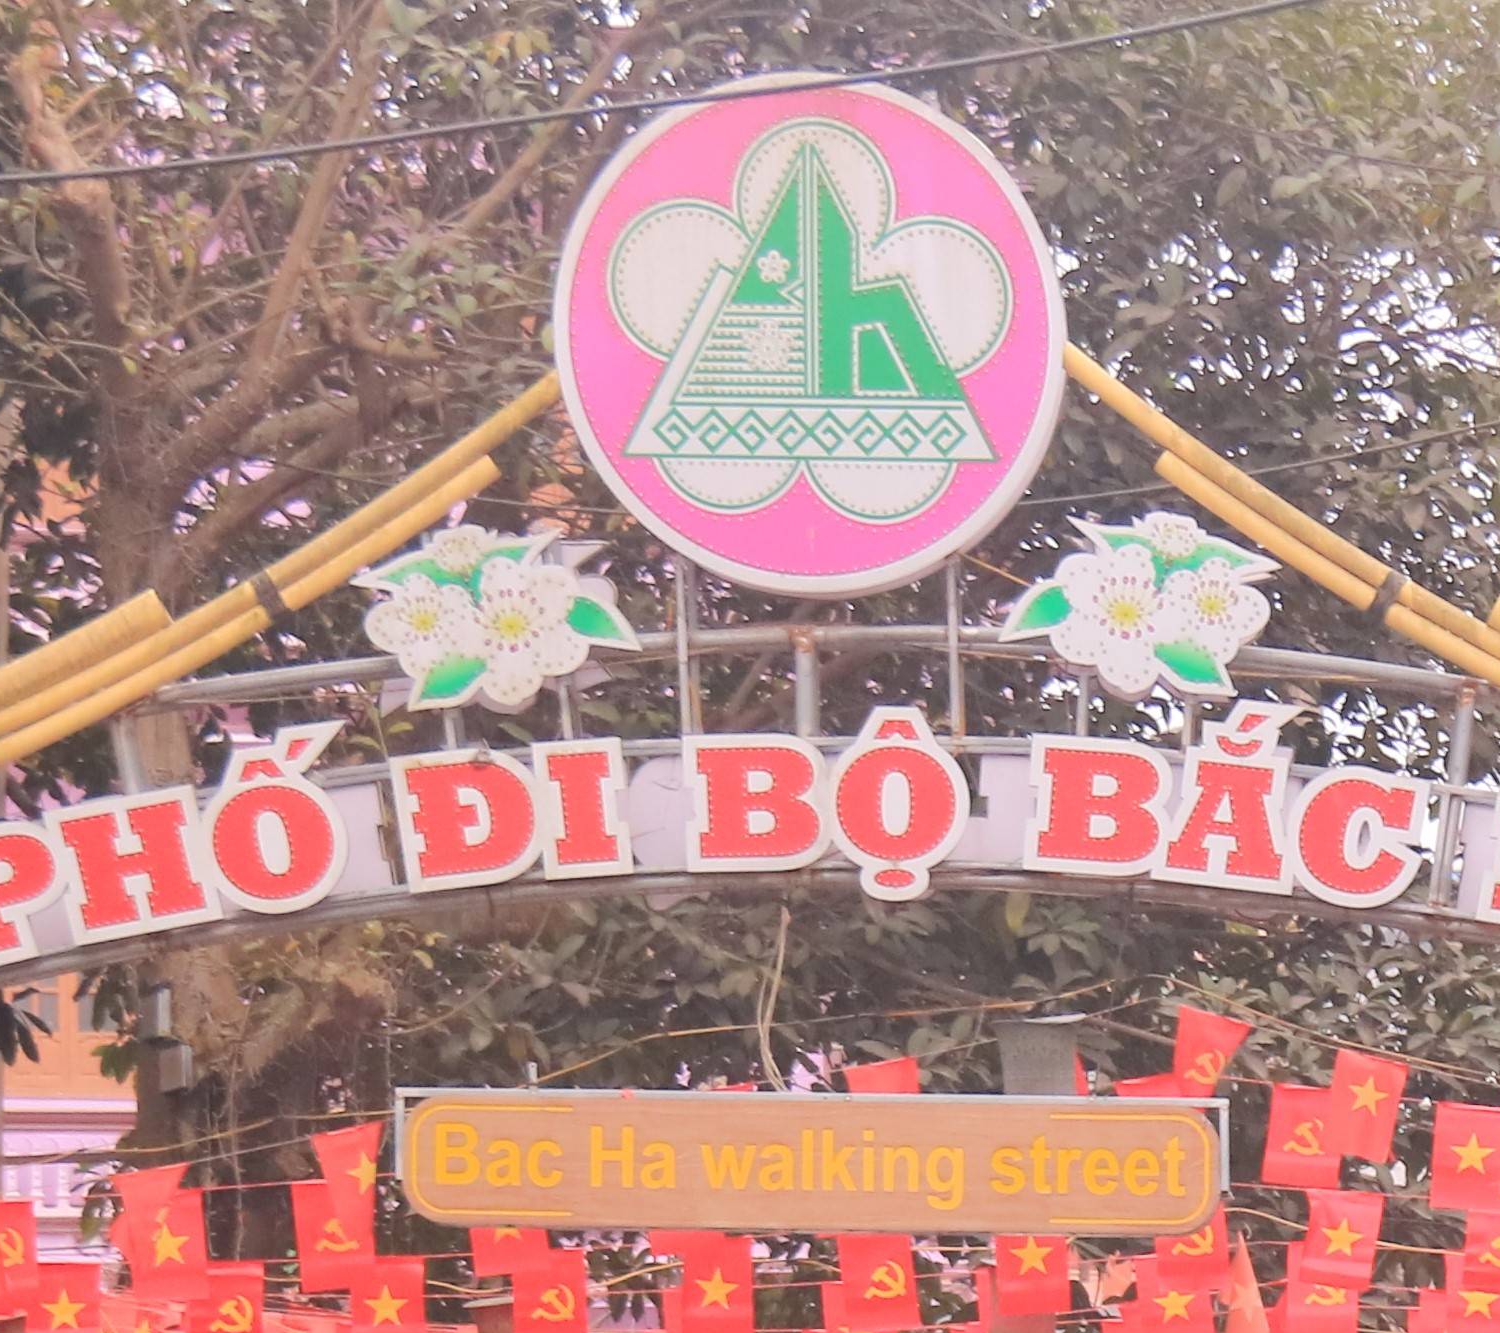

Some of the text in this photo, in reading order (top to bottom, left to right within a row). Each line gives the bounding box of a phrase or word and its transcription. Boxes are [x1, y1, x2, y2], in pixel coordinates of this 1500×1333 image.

[400, 748, 624, 884] ĐI
[692, 714, 962, 894] BỘ
[1032, 710, 1422, 898] BẮC
[433, 1122, 1187, 1211] Bac Ha walking street
